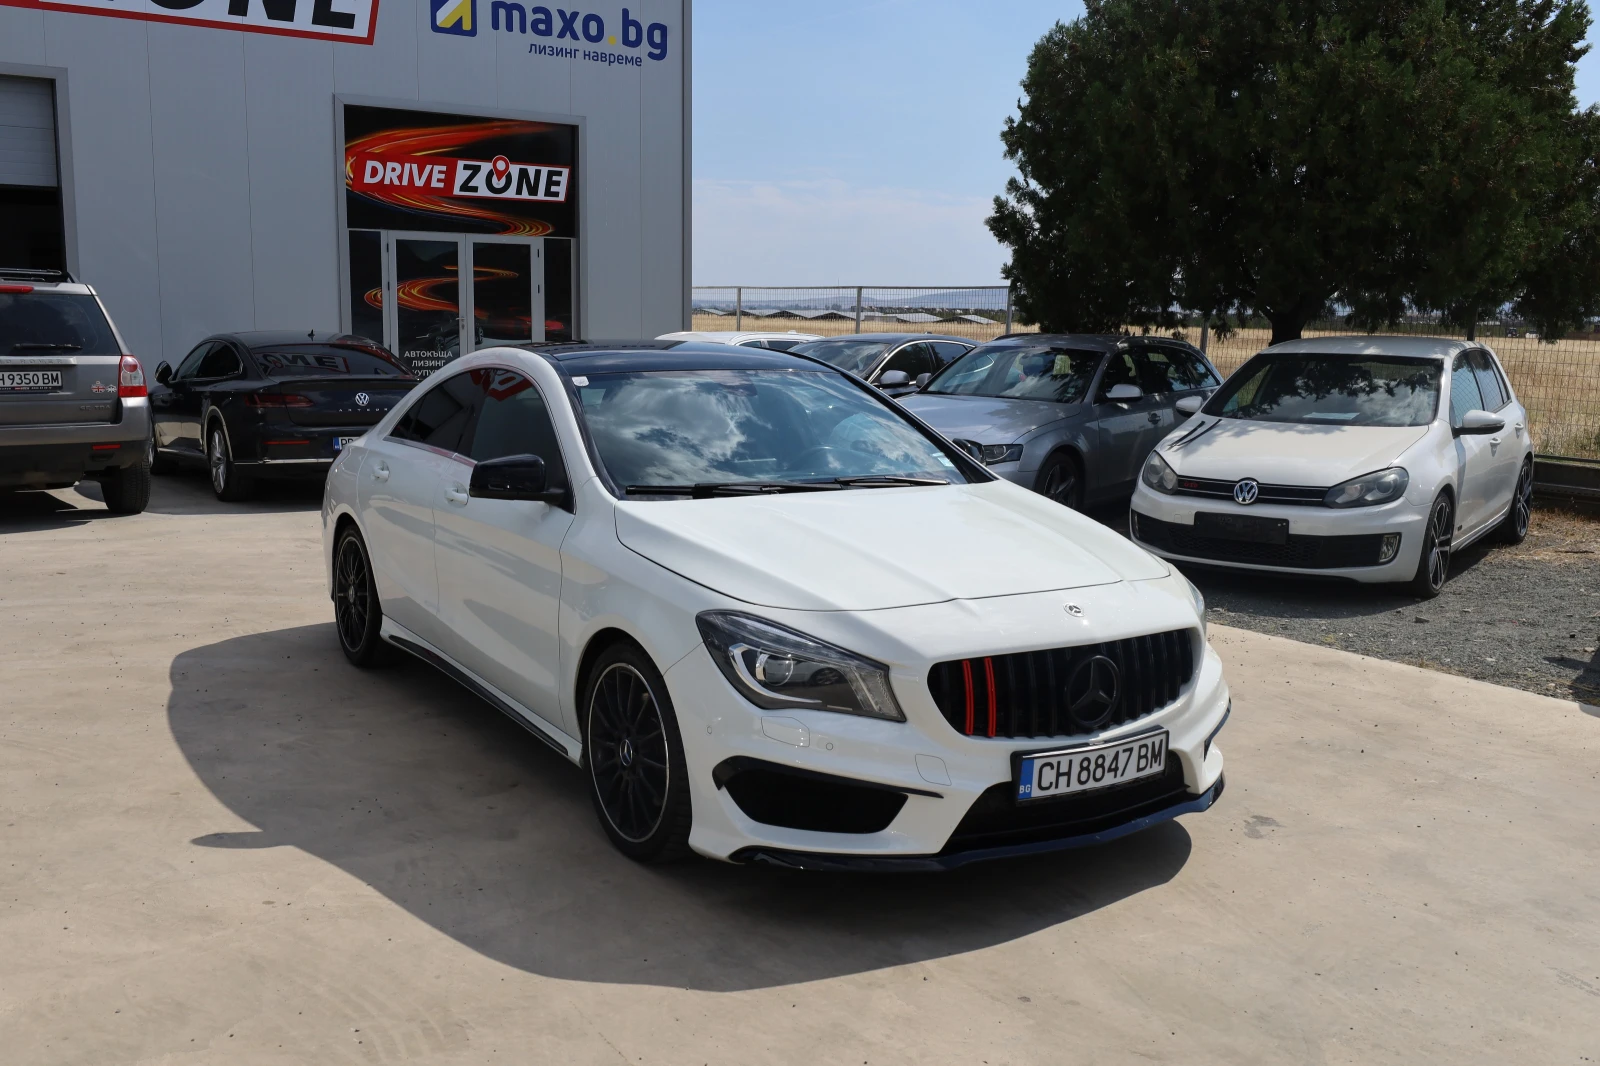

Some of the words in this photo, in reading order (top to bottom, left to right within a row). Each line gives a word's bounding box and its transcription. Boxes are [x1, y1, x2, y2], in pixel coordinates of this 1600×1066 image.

[491, 1, 668, 61] maxo.bg
[528, 43, 579, 59] лизинг
[583, 50, 643, 67] навреме
[363, 160, 447, 188] DRIVE
[459, 163, 563, 198] ZONE
[404, 350, 453, 358] АВТОКЪЩА
[7, 373, 40, 386] 9350
[42, 372, 60, 385] BM
[1019, 785, 1031, 793] BG
[1037, 759, 1073, 791] CH
[1077, 747, 1134, 786] 8847
[1136, 739, 1163, 773] BM
